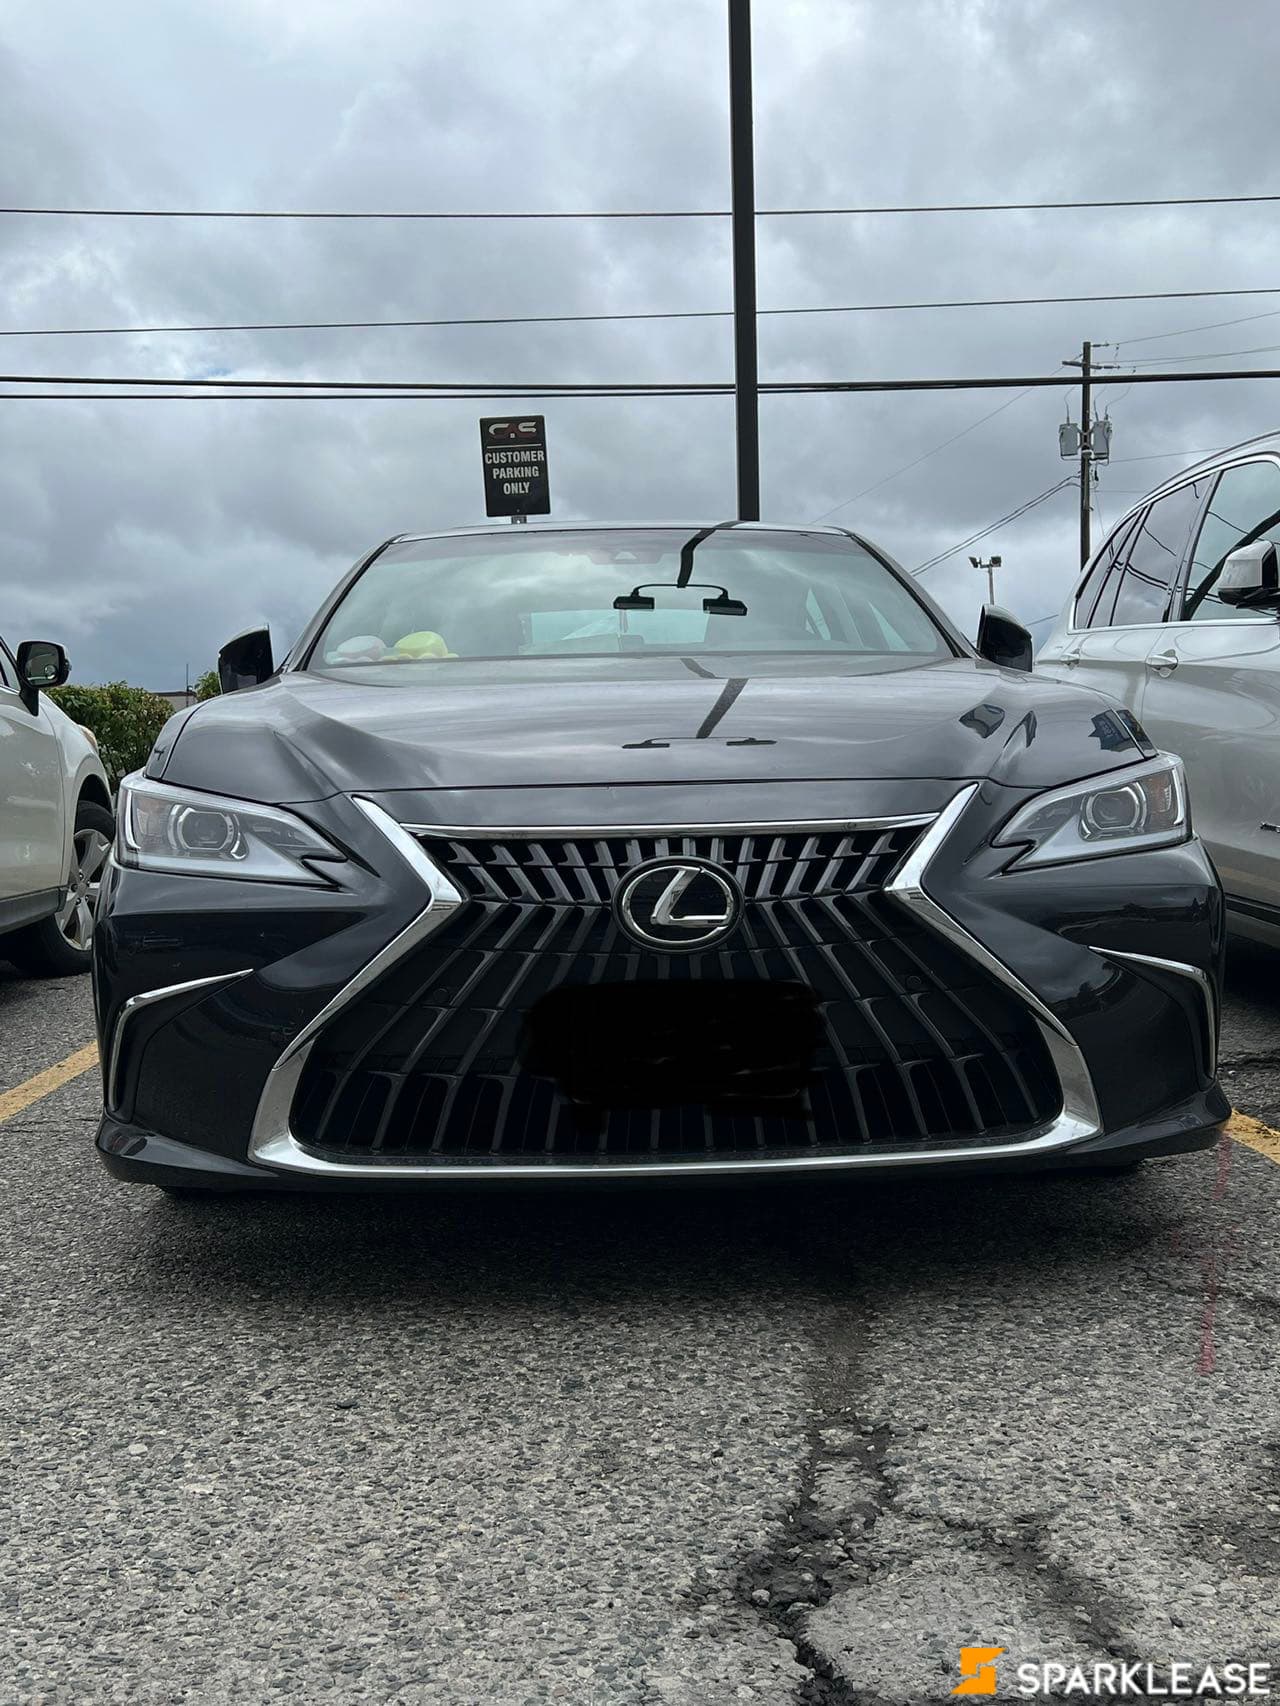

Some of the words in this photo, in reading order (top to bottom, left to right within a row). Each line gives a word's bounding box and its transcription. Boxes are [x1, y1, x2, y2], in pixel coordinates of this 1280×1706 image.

[485, 451, 545, 464] CUSTOMER
[493, 466, 539, 479] PARKING
[503, 482, 530, 495] ONLY
